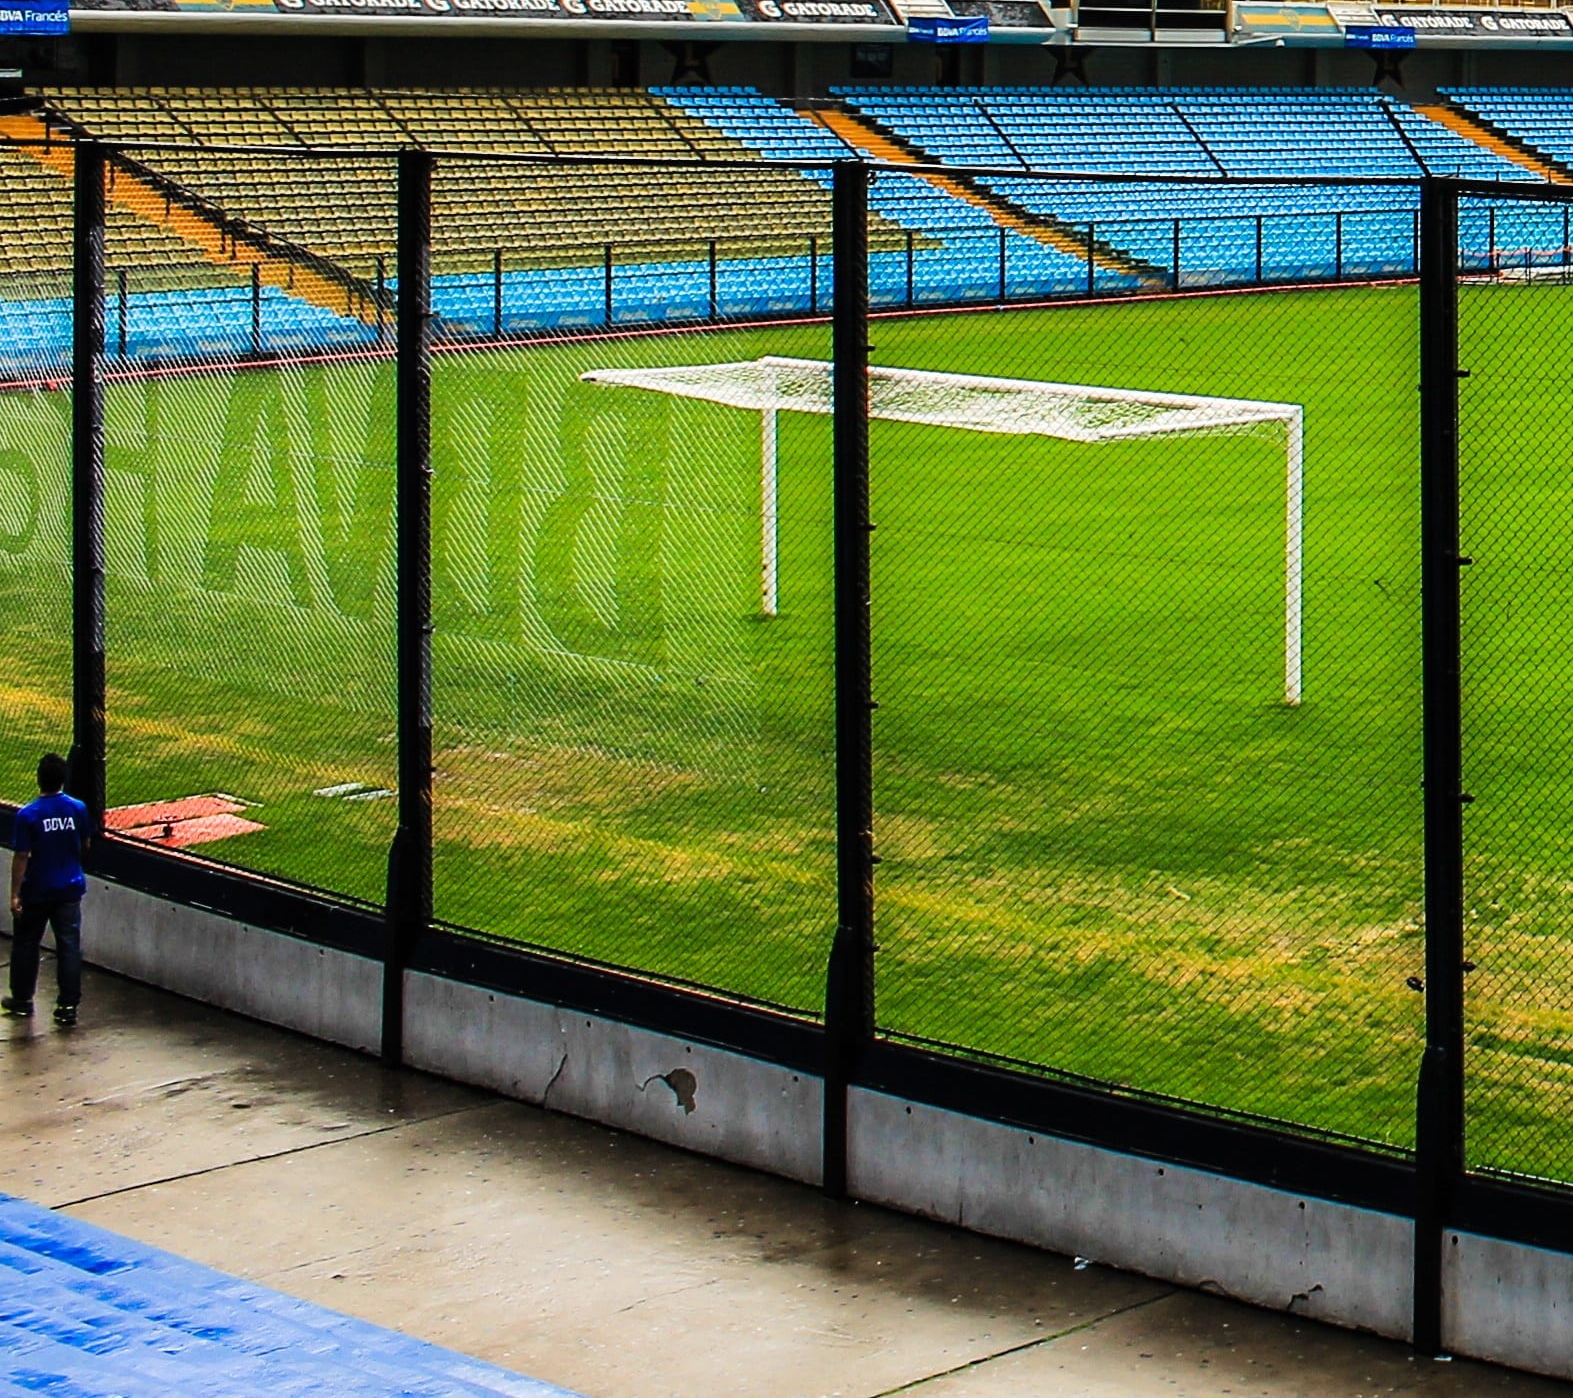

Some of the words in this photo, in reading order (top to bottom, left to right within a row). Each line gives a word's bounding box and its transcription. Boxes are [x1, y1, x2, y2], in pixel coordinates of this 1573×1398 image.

[25, 9, 68, 22] Francés
[784, 2, 877, 17] GATORADE
[1500, 17, 1569, 30] GATORADE
[41, 816, 76, 832] BBVA
